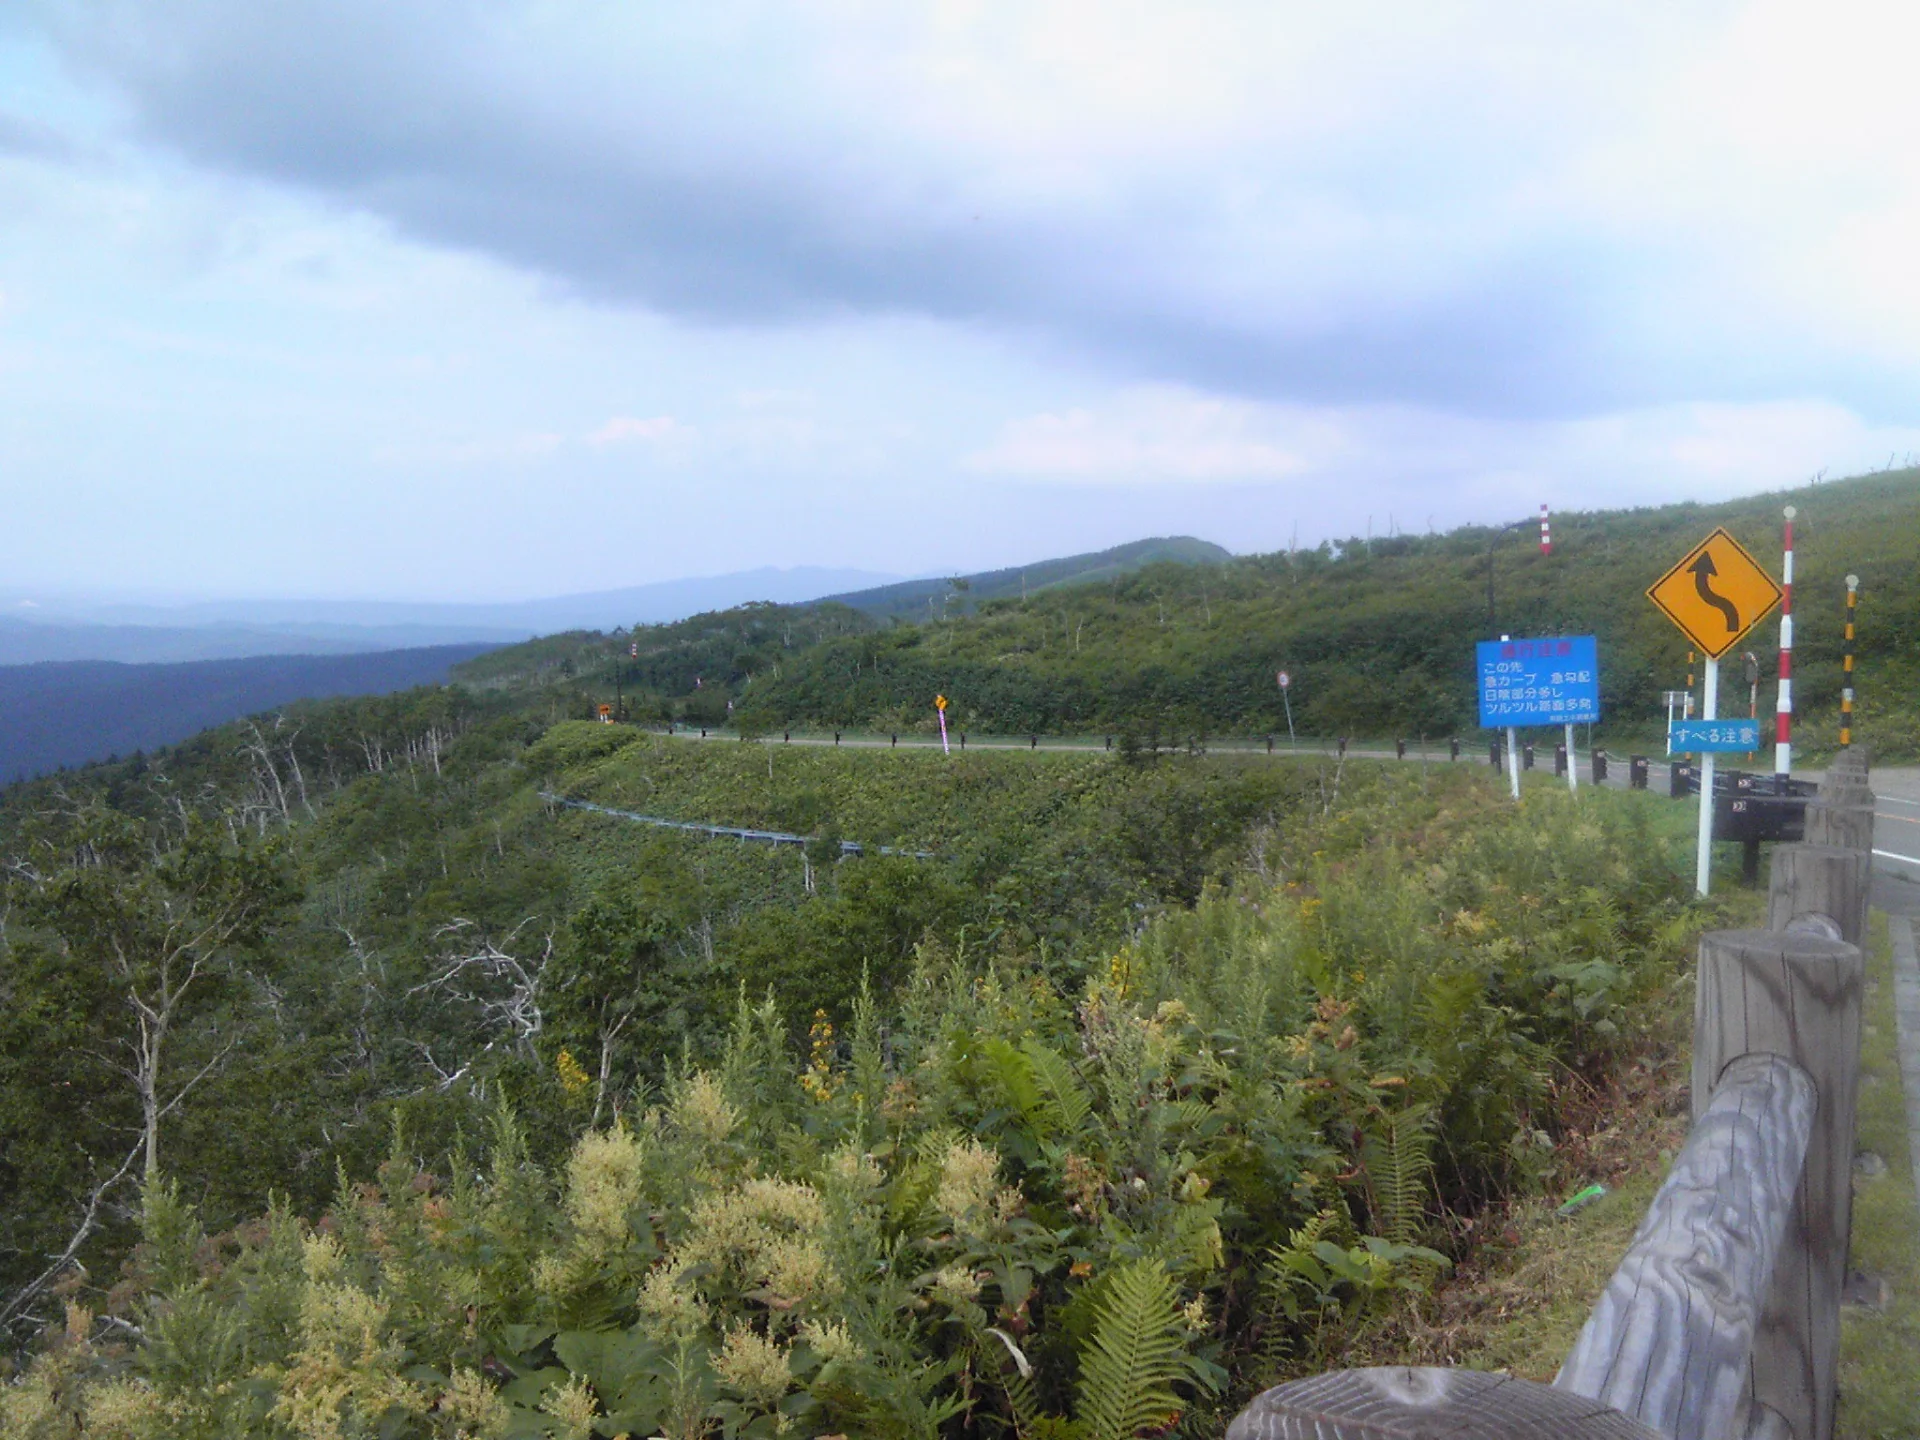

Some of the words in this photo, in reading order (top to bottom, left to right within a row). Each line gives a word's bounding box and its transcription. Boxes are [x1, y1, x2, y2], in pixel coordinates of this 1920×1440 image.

[1484, 661, 1523, 674] この先
[1675, 727, 1757, 745] すべる注意
